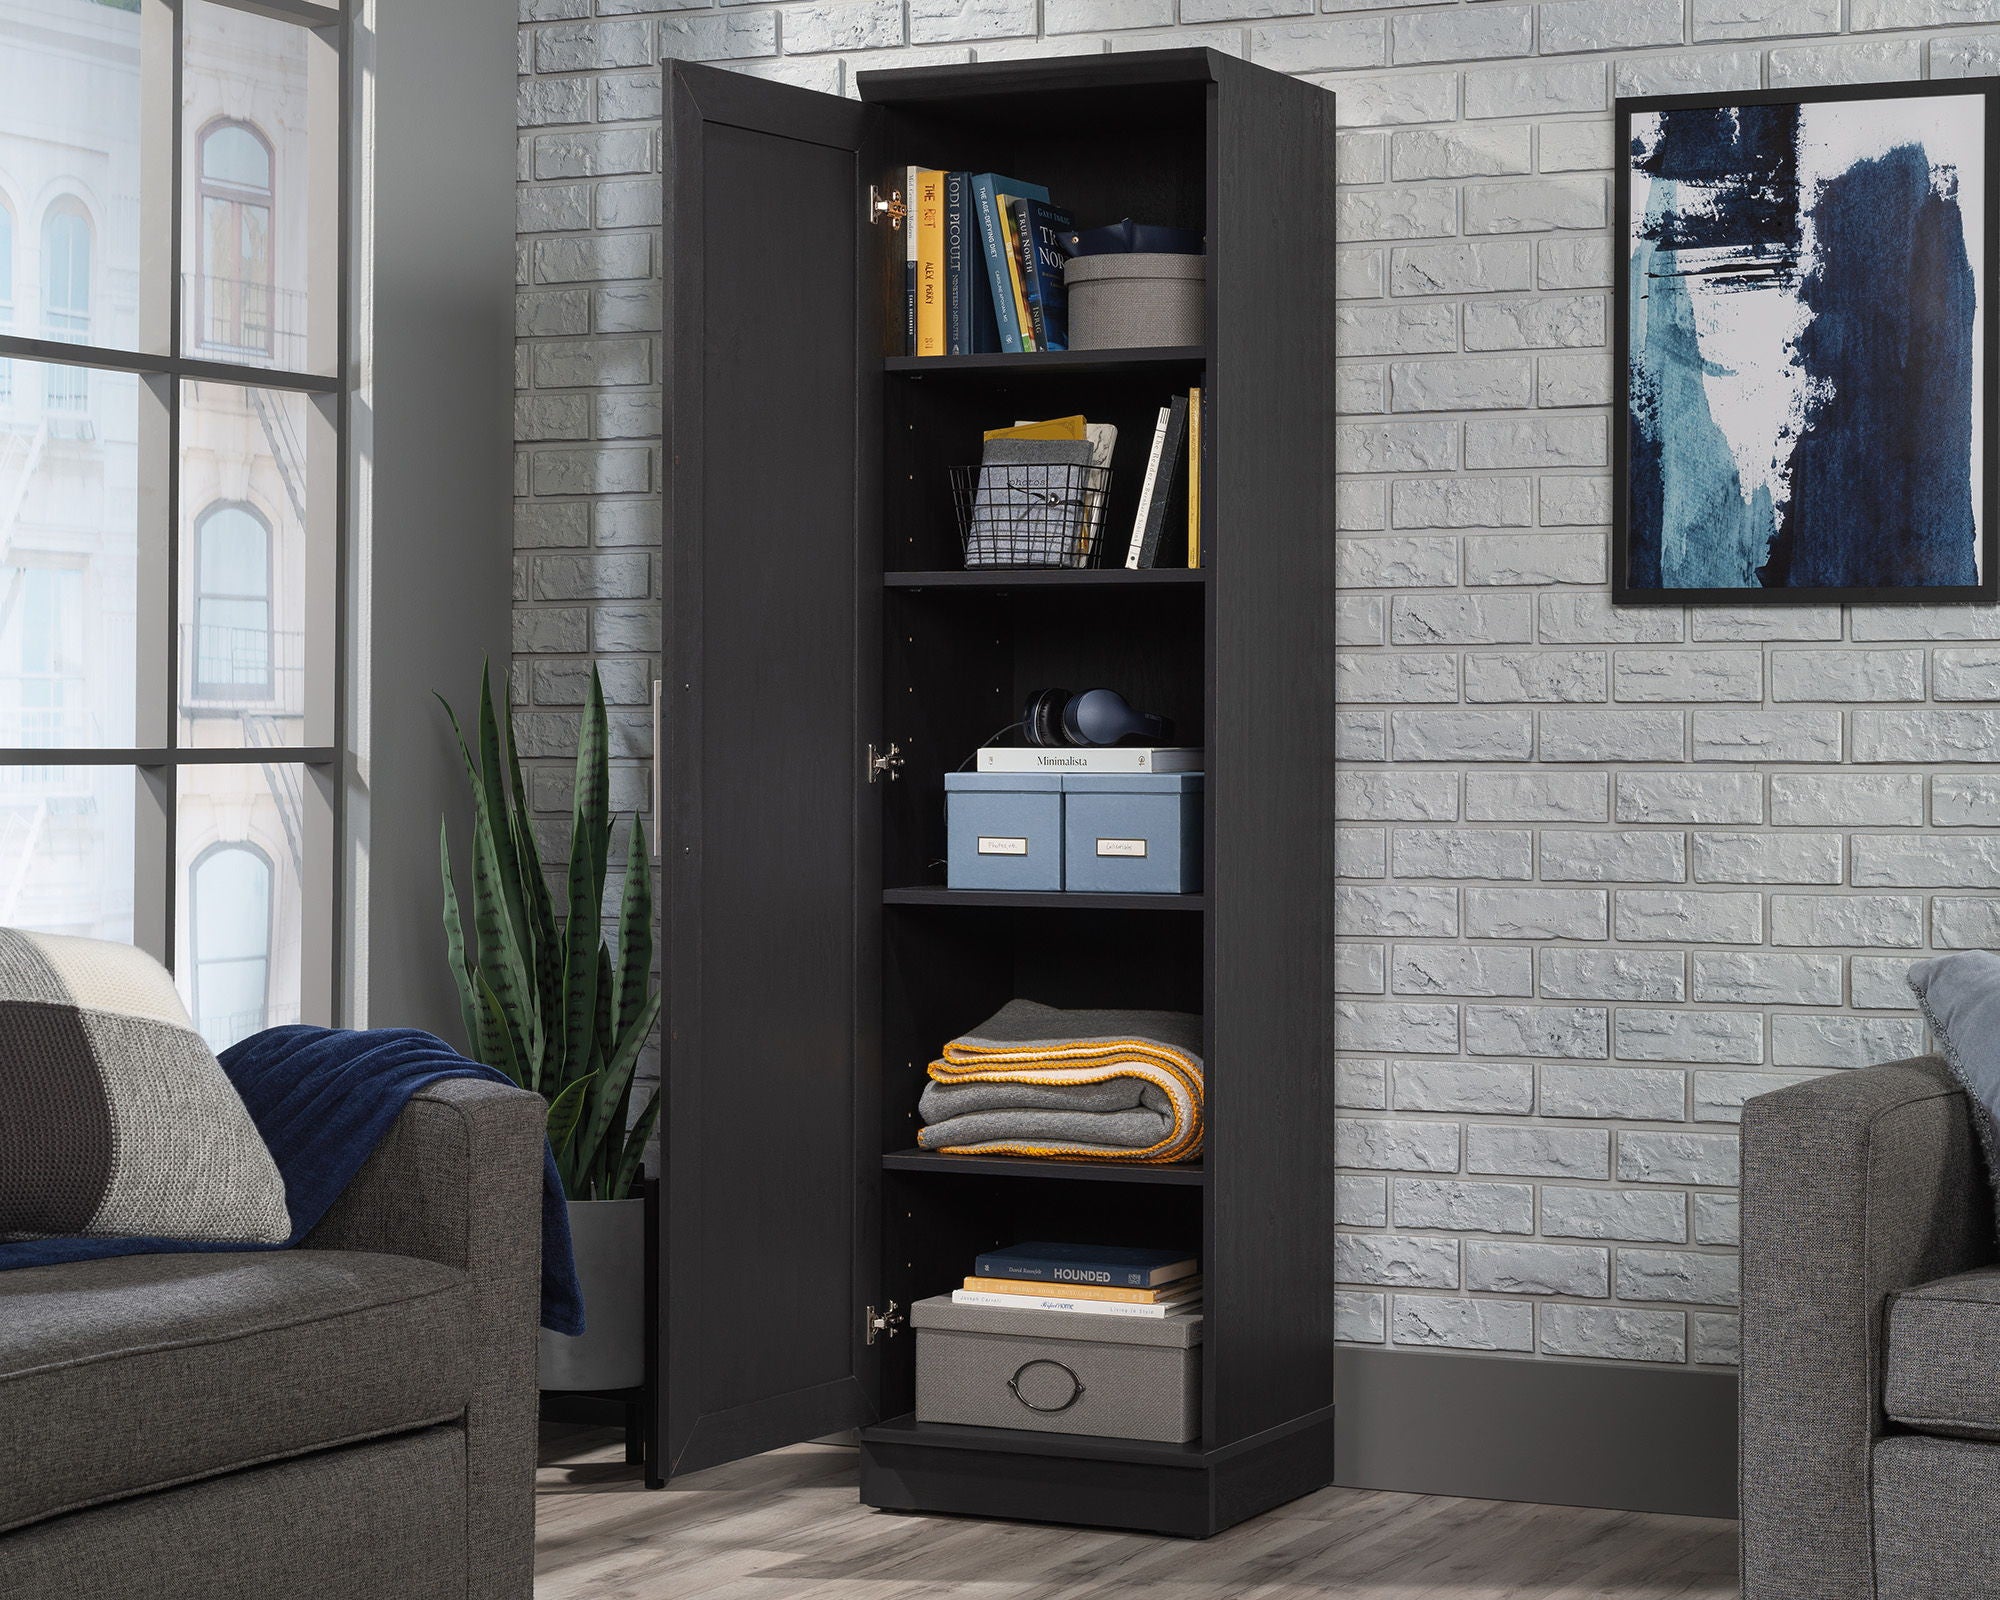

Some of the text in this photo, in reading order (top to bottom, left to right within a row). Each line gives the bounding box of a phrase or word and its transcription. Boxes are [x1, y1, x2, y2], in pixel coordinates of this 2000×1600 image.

[924, 183, 936, 202] THE
[948, 176, 961, 272] JODI PICOULT
[979, 186, 998, 259] THE AGE-DEFYING DIET
[1018, 211, 1034, 273] TRUE NORTH
[924, 261, 935, 305] ALEX PERRY
[1147, 452, 1159, 481] Reader
[1036, 755, 1088, 767] Minimalista
[1054, 1268, 1111, 1283] HOUNDED
